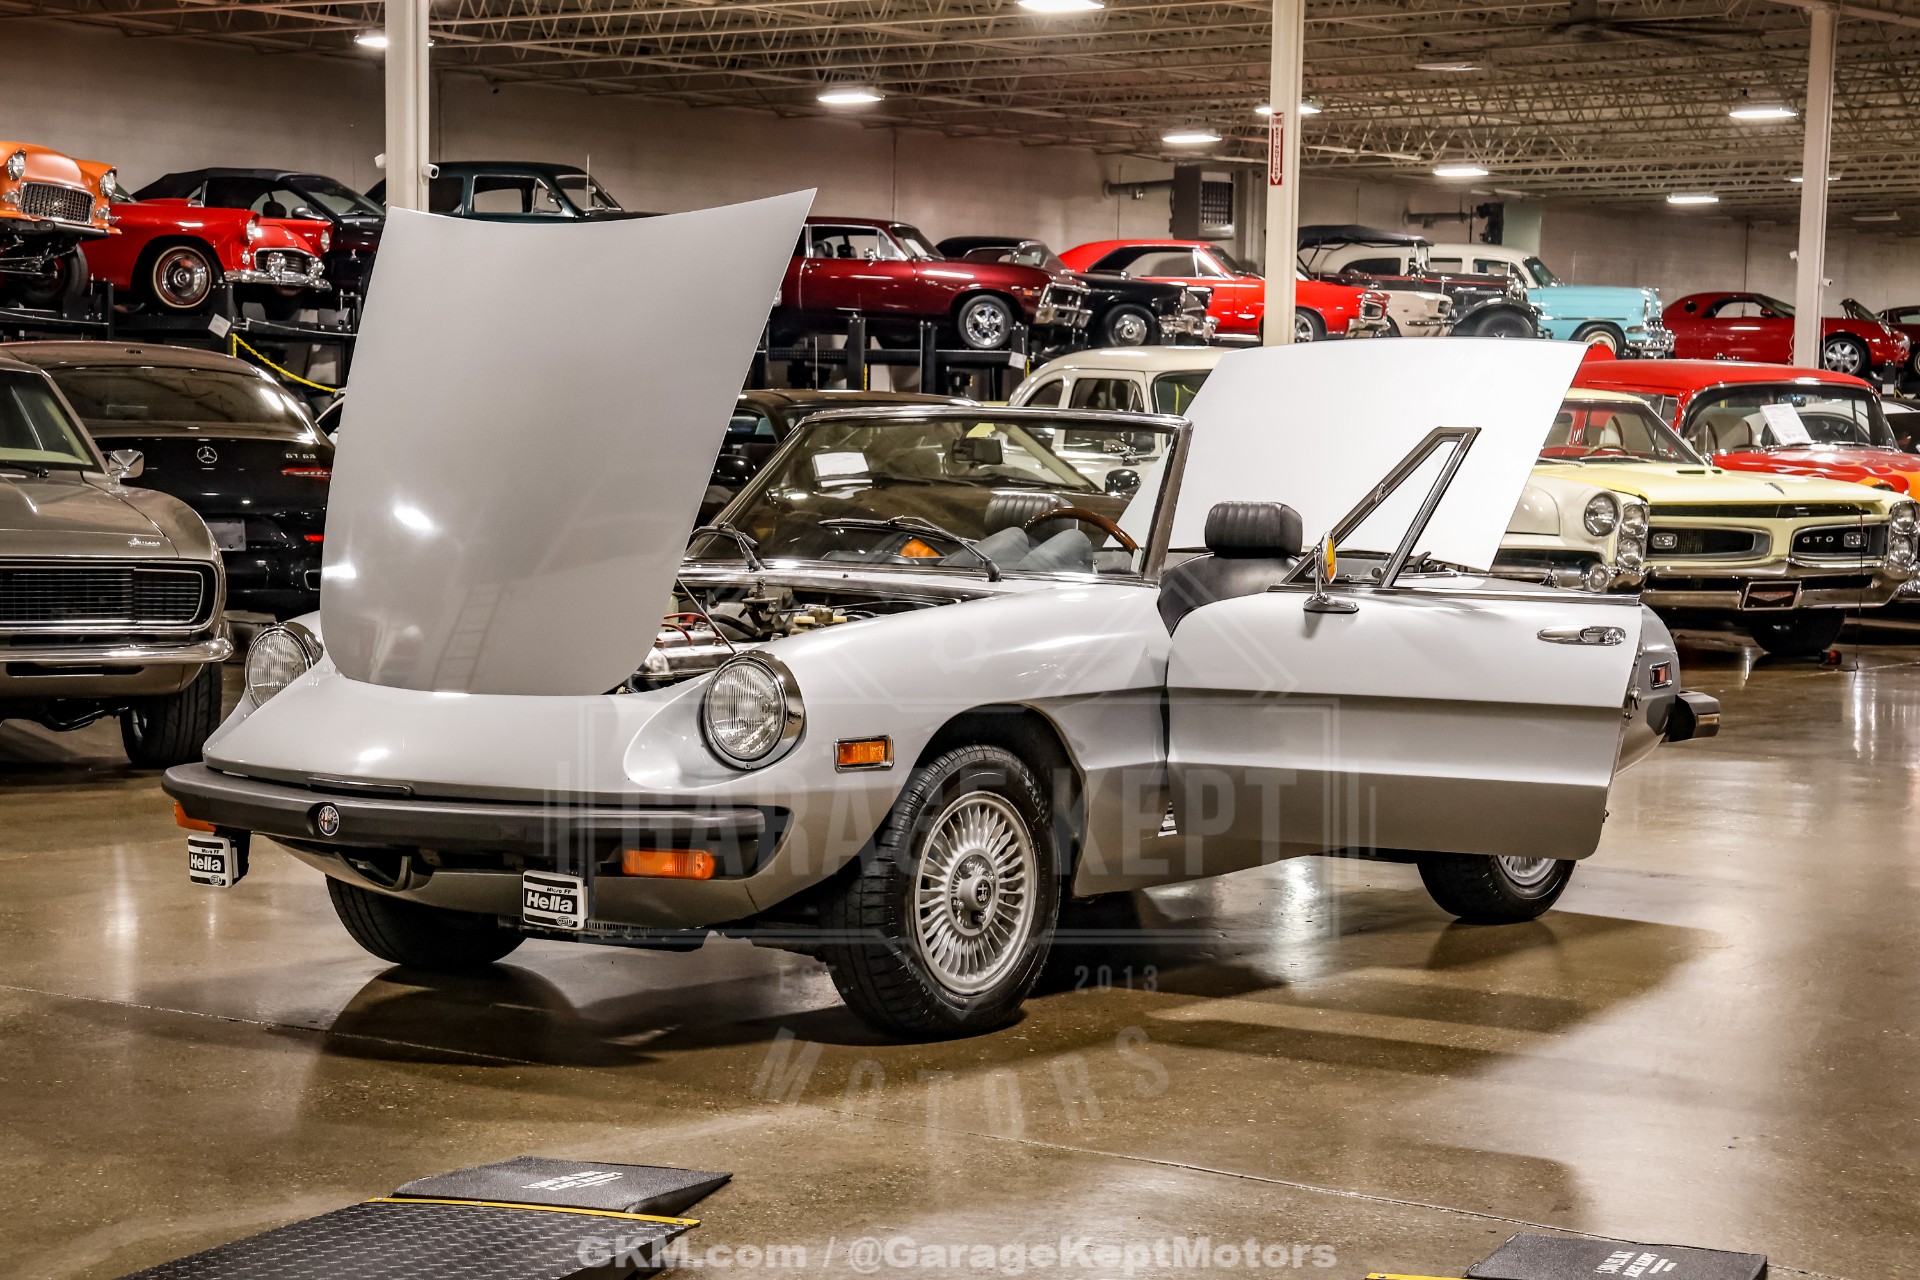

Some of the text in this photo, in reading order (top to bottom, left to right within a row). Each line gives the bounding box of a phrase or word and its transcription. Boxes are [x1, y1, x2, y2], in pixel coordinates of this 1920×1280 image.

[1802, 535, 1834, 544] GTO
[190, 853, 222, 872] Hella
[546, 886, 563, 894] Micro
[526, 890, 573, 913] Hella
